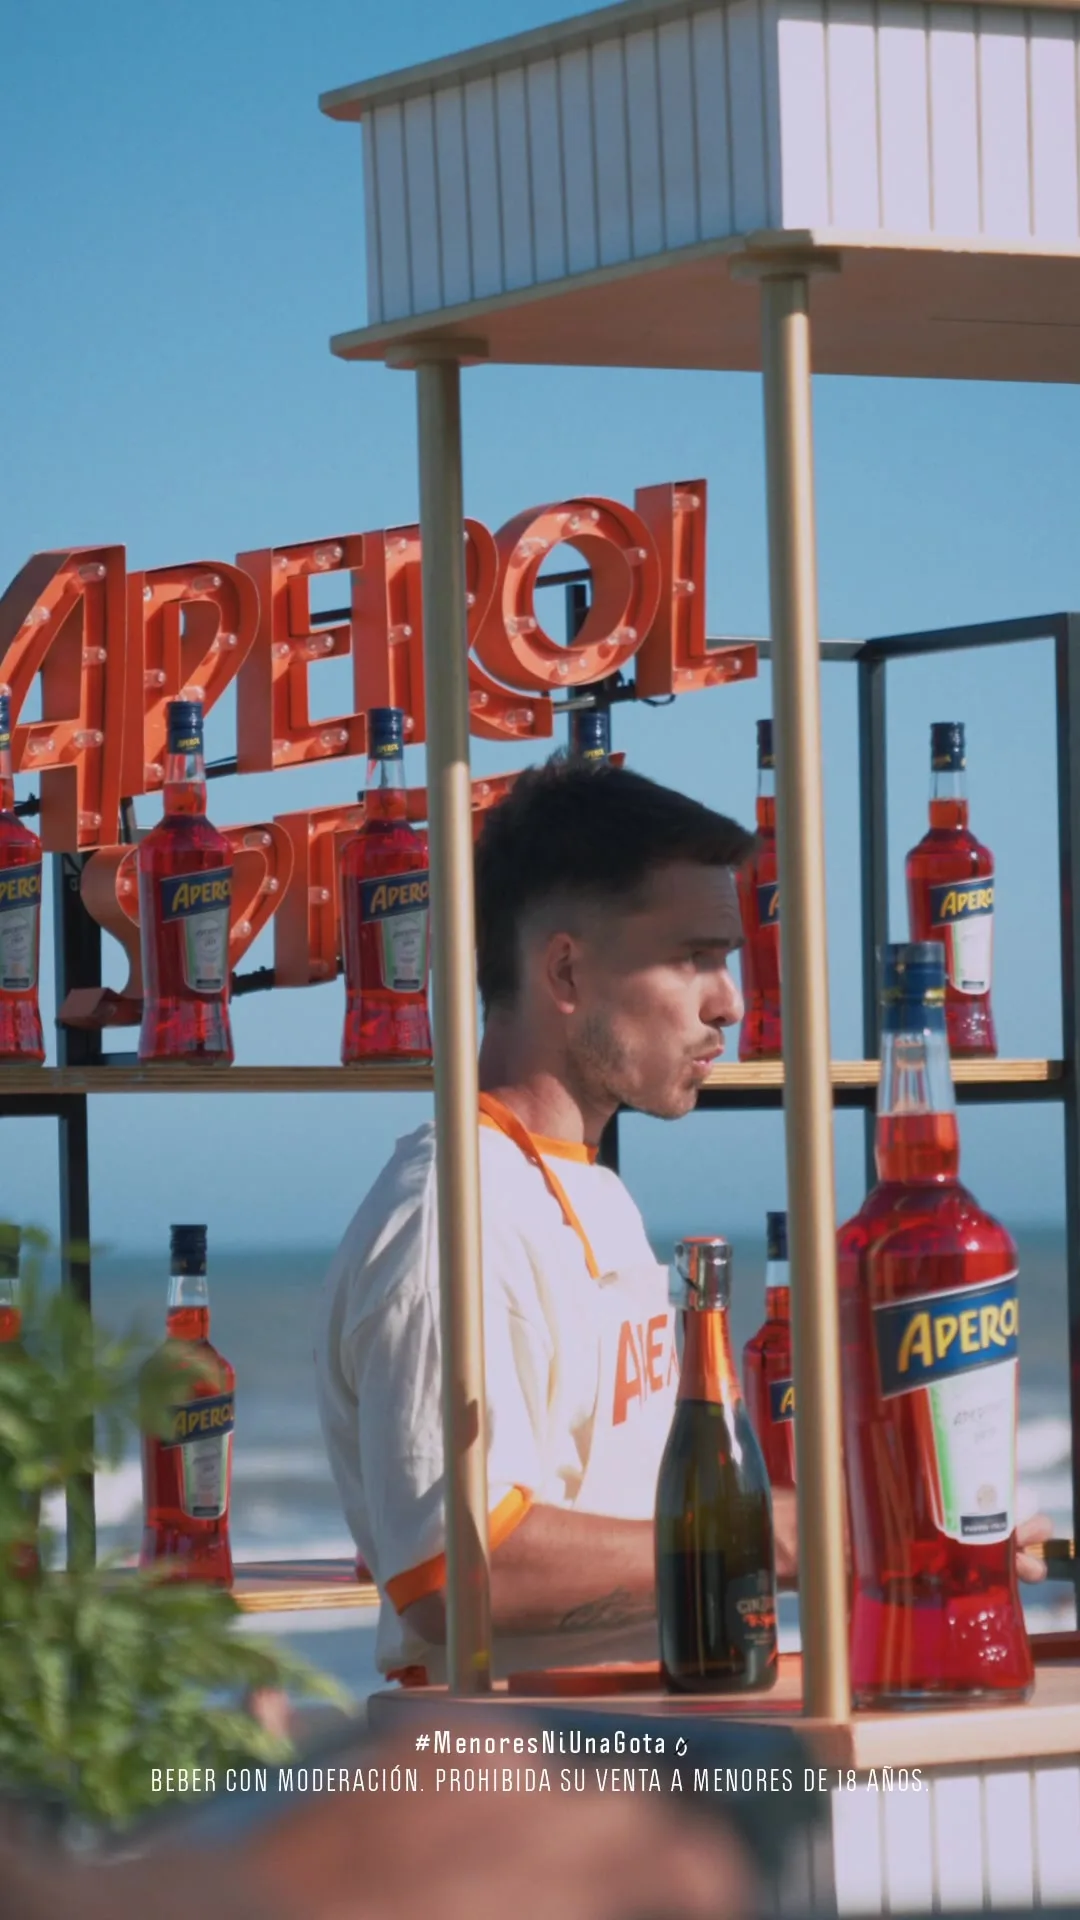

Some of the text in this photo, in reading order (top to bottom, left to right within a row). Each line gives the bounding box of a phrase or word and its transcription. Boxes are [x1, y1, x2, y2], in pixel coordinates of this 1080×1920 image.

[0, 478, 758, 853] APEROL
[172, 879, 231, 912] APERO
[370, 880, 430, 913] APERO
[939, 887, 994, 919] APERO
